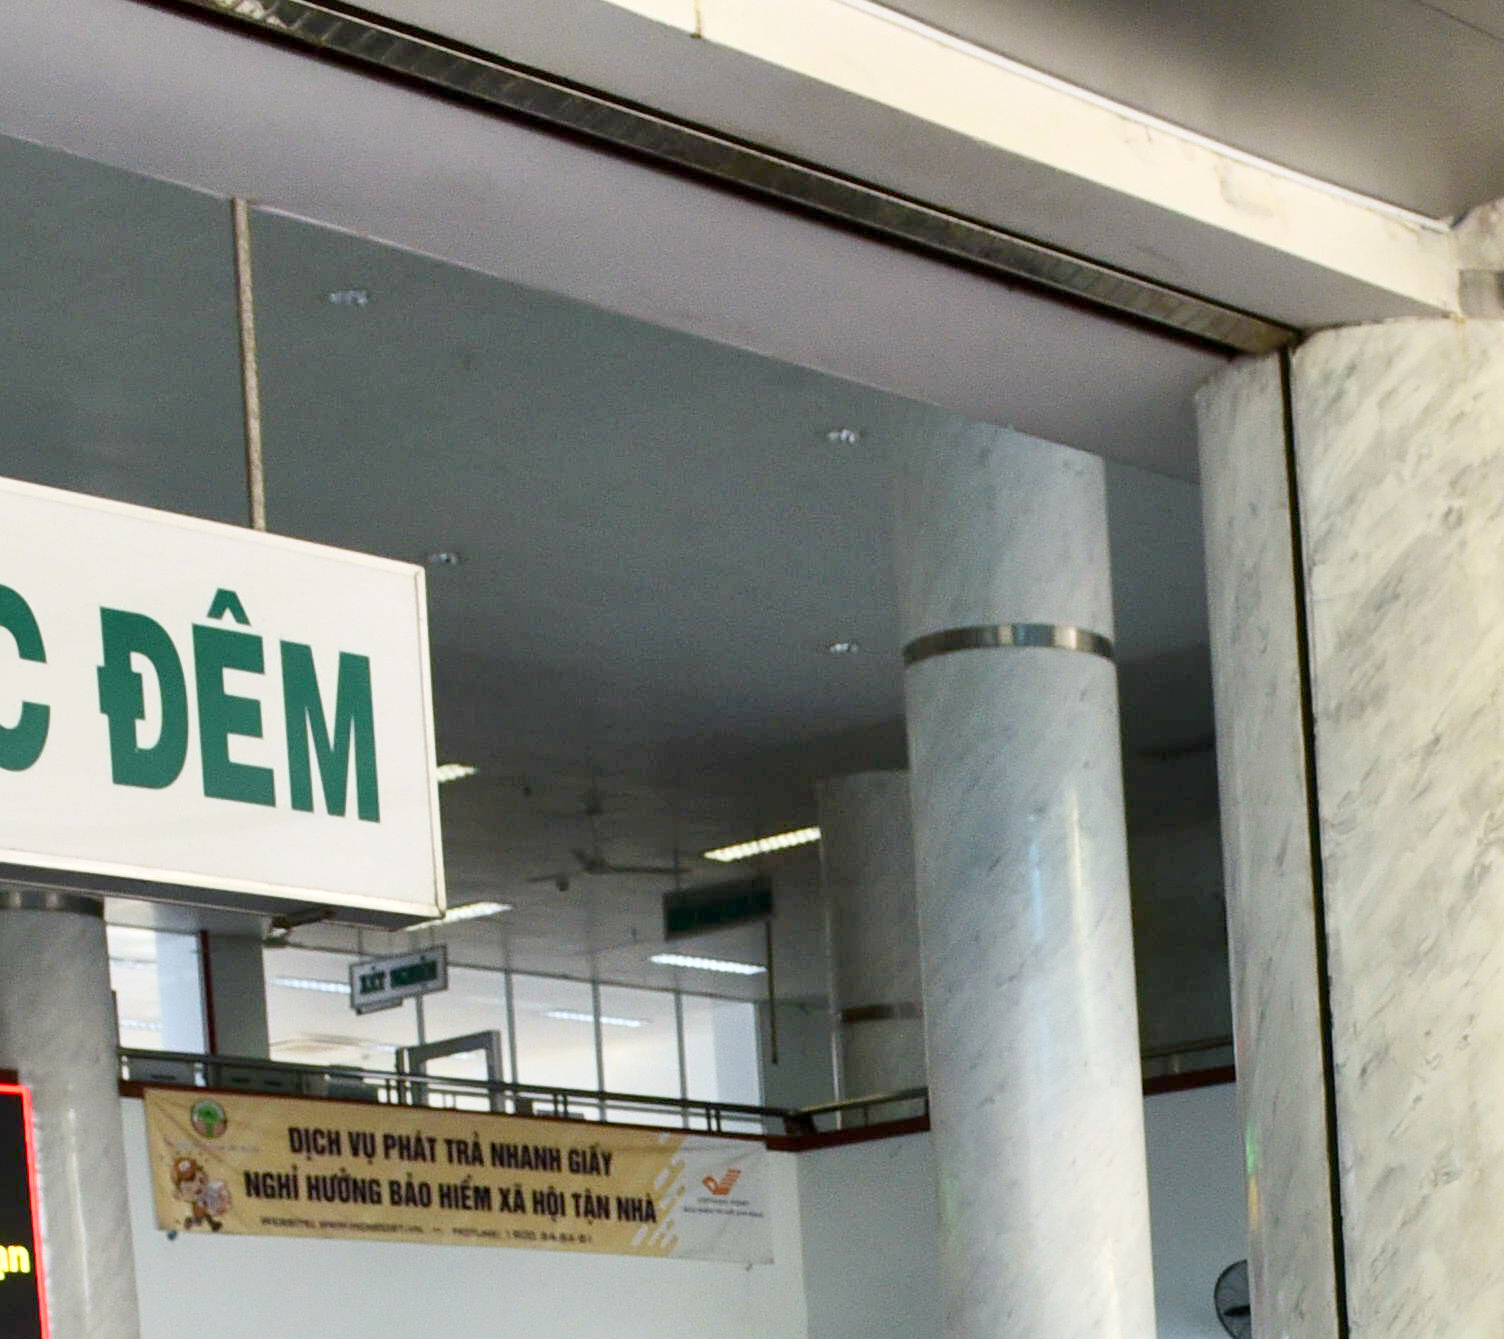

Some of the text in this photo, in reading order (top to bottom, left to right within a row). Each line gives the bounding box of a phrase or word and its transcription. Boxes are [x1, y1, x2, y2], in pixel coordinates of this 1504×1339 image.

[98, 589, 379, 821] ĐÊM
[288, 1127, 613, 1176] DỊCH VỤ PHÁT TRẢ NHANH GIẤY
[244, 1163, 299, 1200] NGHỈ
[306, 1167, 382, 1205] HƯỞNG
[389, 1172, 432, 1208] BẢO
[438, 1174, 492, 1211] HIỂM
[499, 1183, 526, 1213] XÃ
[531, 1185, 566, 1222] HỘI
[571, 1188, 610, 1225] TẬN
[616, 1193, 656, 1223] NHÀ
